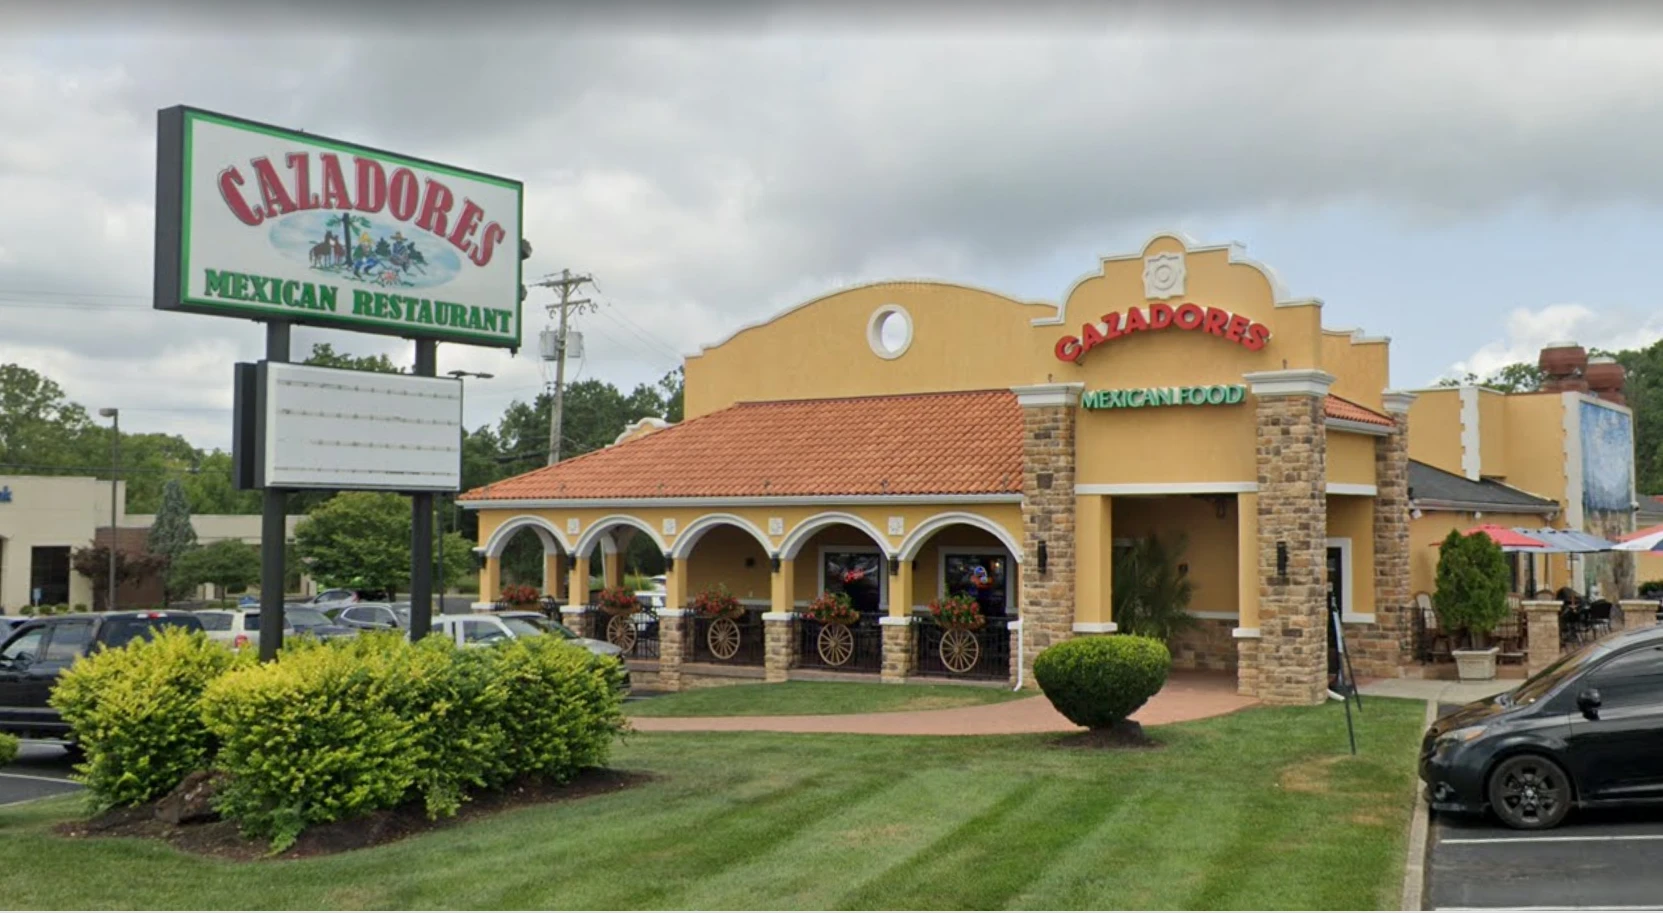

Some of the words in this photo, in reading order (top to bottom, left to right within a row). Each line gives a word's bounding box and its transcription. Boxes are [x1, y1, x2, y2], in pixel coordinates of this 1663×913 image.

[217, 151, 506, 268] CAZADORES
[203, 268, 339, 312] MEXICAN
[351, 289, 513, 333] RESTAURANT
[1054, 302, 1270, 363] CAZADORES
[1081, 388, 1175, 410] MEXICAN
[1177, 384, 1247, 407] FOOD
